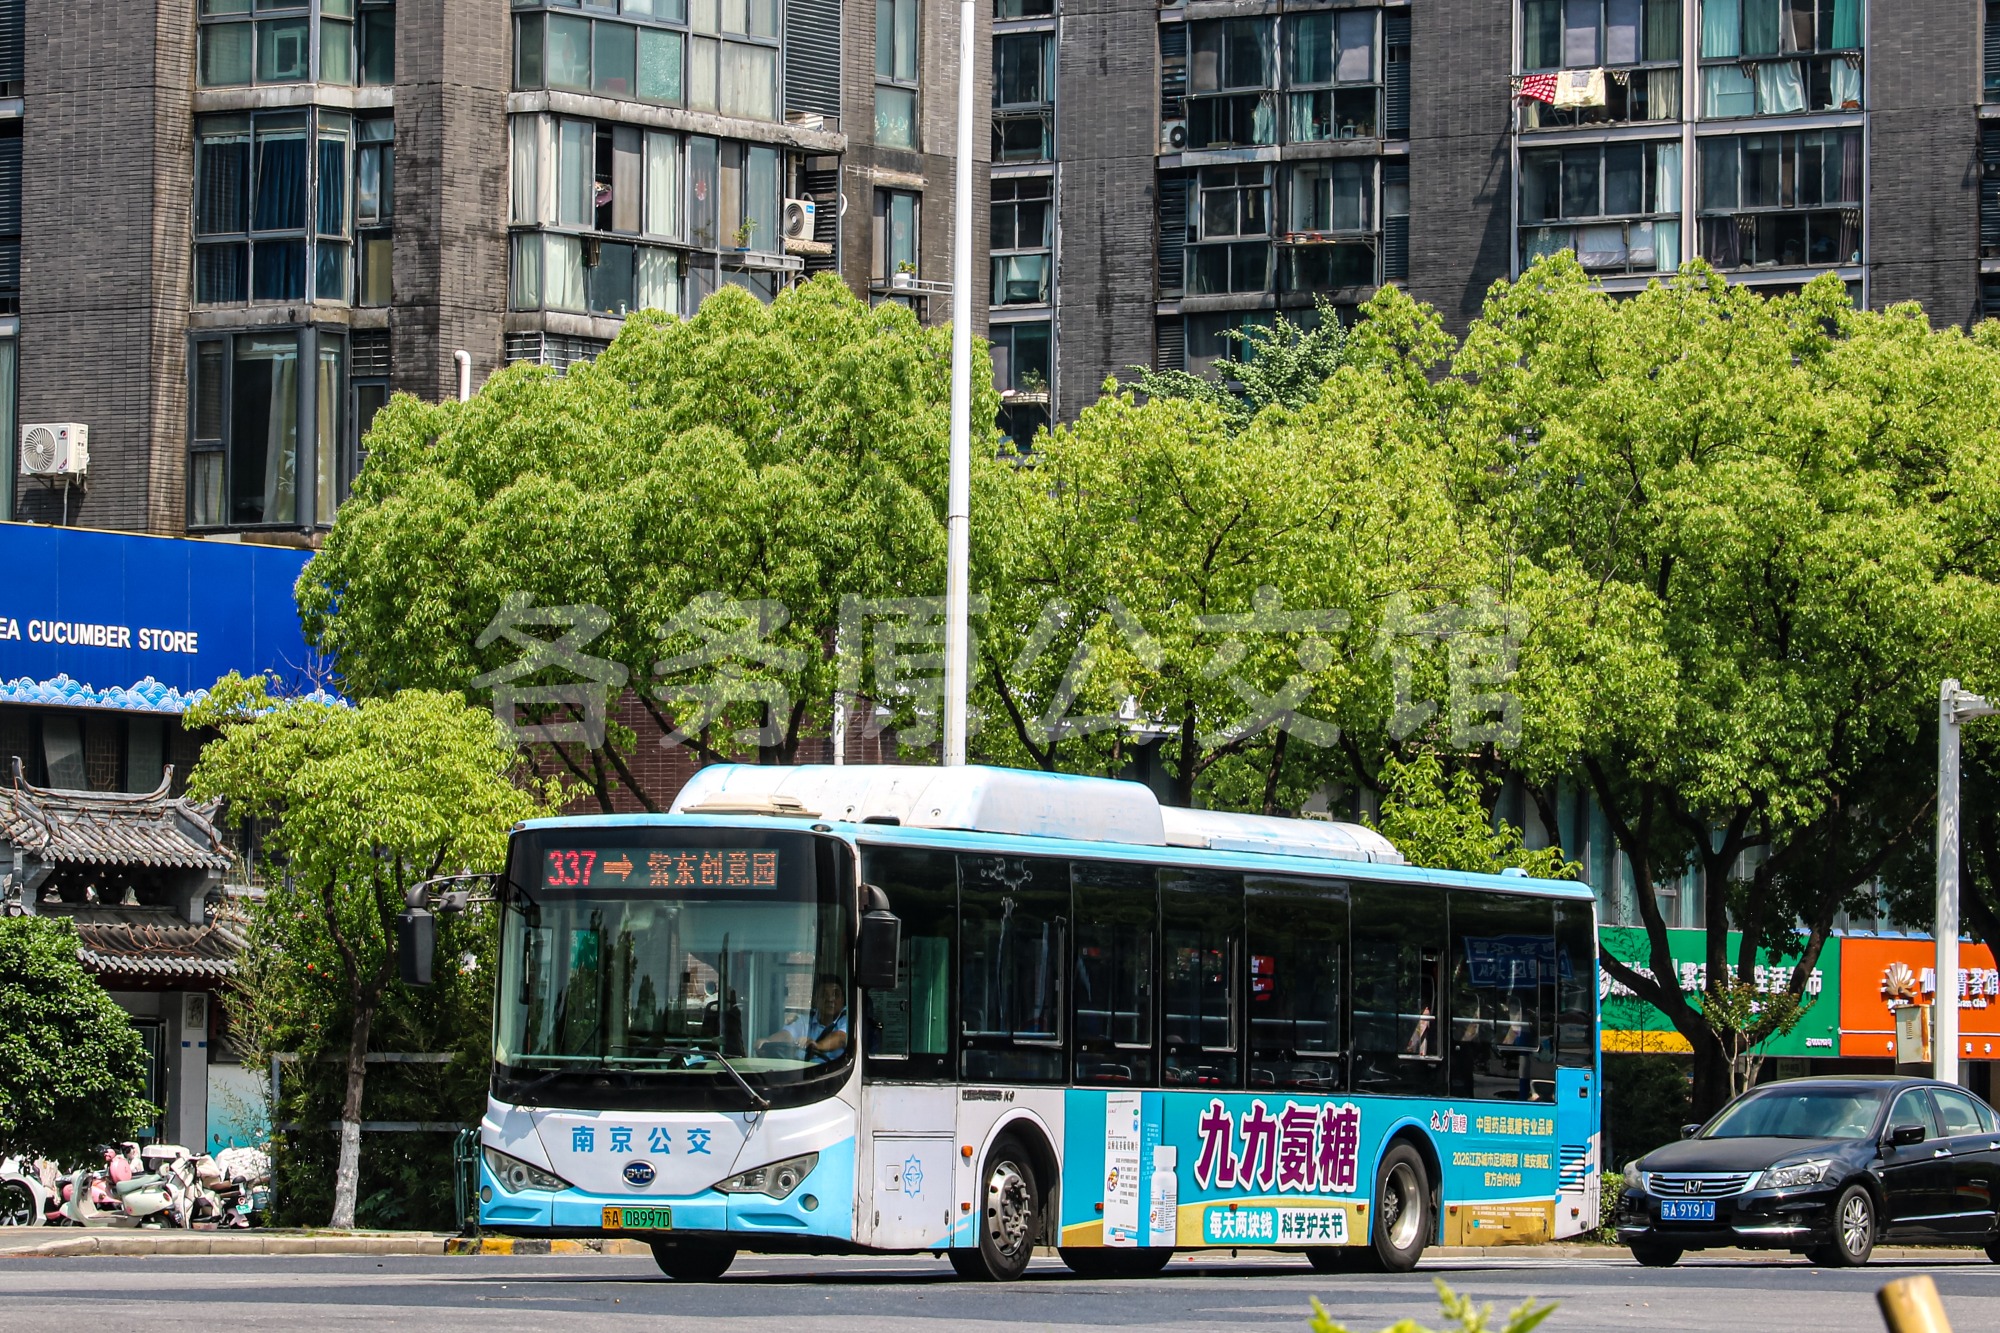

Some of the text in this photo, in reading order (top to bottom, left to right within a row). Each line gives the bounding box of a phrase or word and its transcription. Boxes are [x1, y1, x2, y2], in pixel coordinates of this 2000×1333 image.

[28, 620, 131, 648] CUCUMBER
[139, 627, 198, 653] STORE
[548, 850, 777, 886] 337 紫东创意园
[1476, 1115, 1553, 1136] 中国药品氨糖专业品牌
[572, 1126, 711, 1154] 南京公交
[1195, 1100, 1360, 1191] 九力氨糖
[626, 1168, 652, 1179] BYD
[1484, 1172, 1521, 1187] 官方合作伙伴
[1210, 1211, 1273, 1239] 每天两块钱
[1281, 1212, 1343, 1239] 科学护关节
